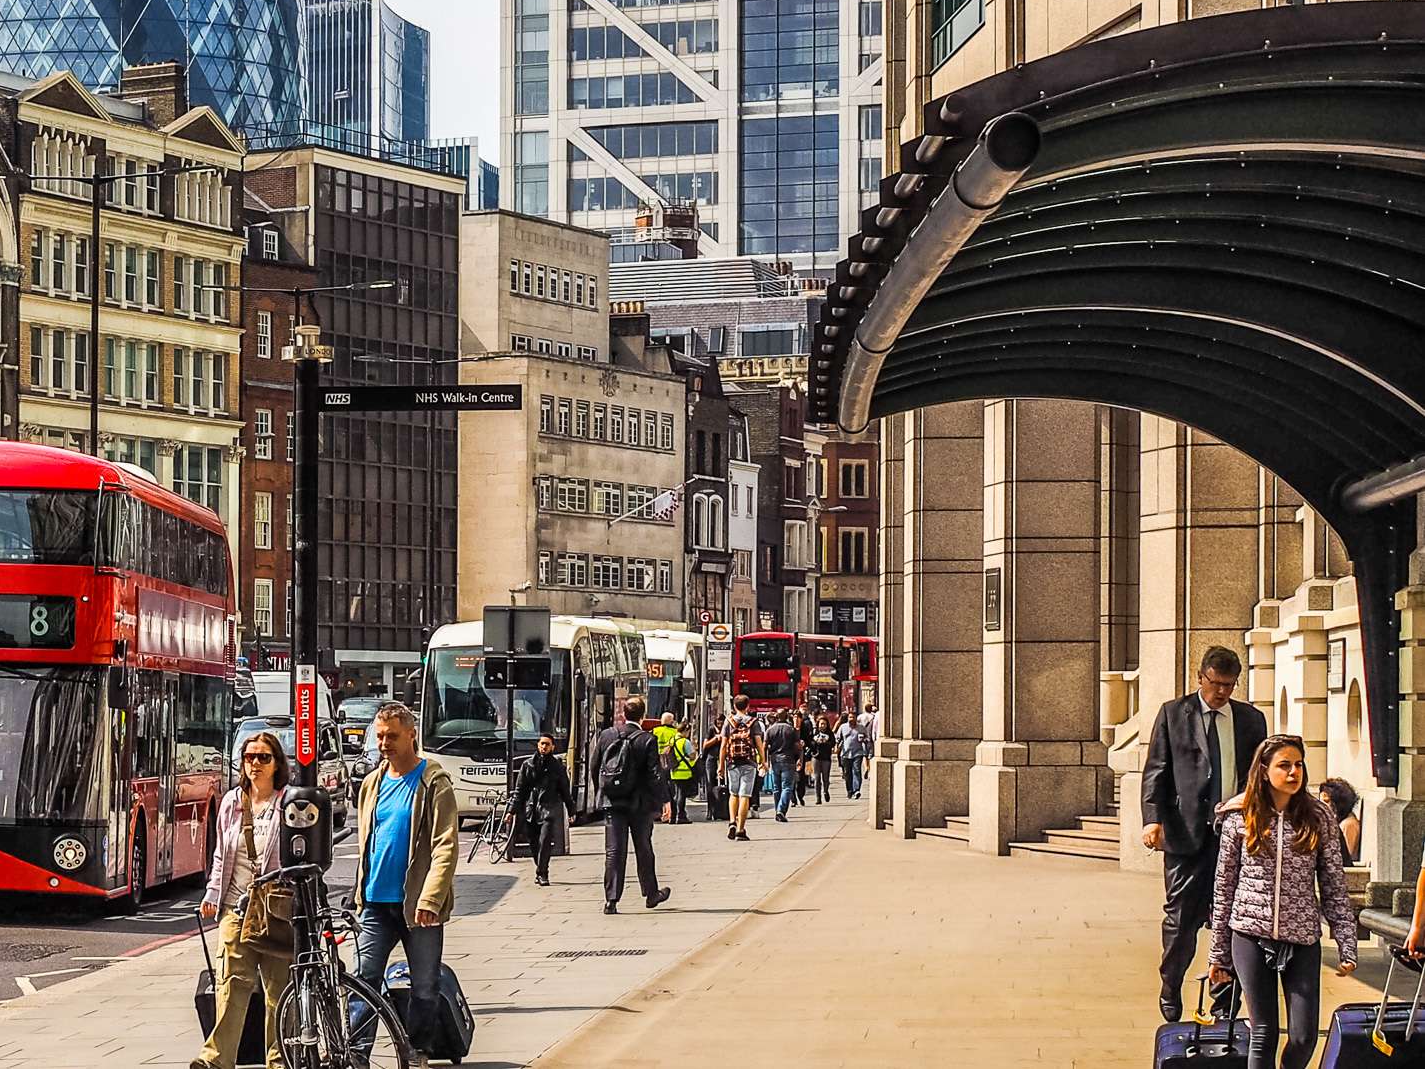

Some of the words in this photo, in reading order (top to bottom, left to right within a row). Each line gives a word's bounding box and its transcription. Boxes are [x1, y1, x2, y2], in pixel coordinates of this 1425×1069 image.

[326, 394, 350, 404] NHS
[415, 393, 438, 403] NHS
[442, 392, 478, 403] Walk-in
[481, 392, 514, 403] Centre
[30, 605, 49, 636] 8
[700, 612, 711, 623] G
[299, 689, 310, 720] butts
[301, 728, 312, 755] gum
